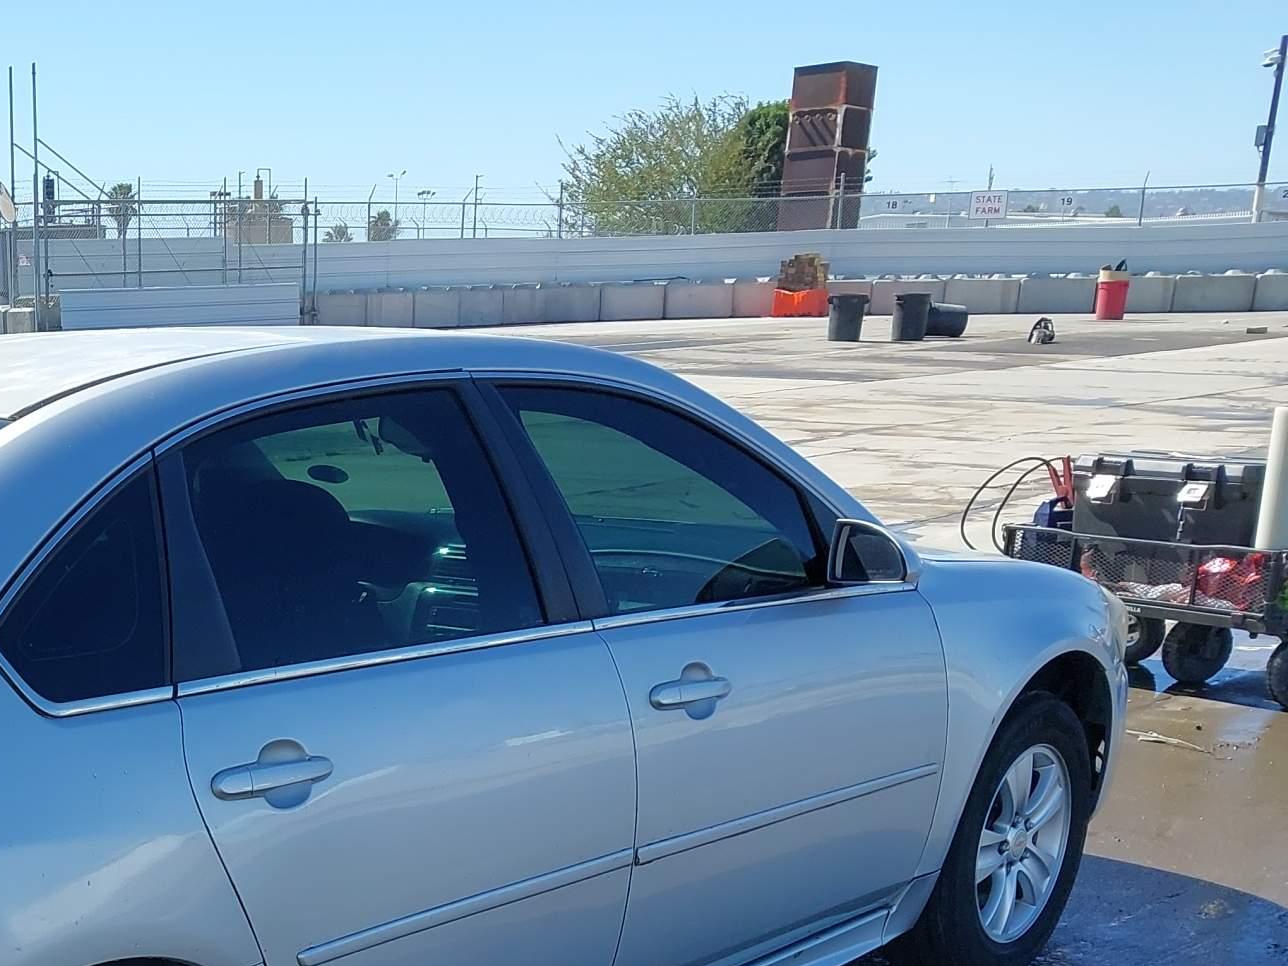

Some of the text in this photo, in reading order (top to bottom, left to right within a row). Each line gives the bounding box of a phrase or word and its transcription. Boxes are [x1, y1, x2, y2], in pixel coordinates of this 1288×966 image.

[975, 196, 1003, 204] STATE
[1060, 198, 1073, 206] 19
[886, 200, 898, 209] 18
[975, 206, 1001, 214] FARM
